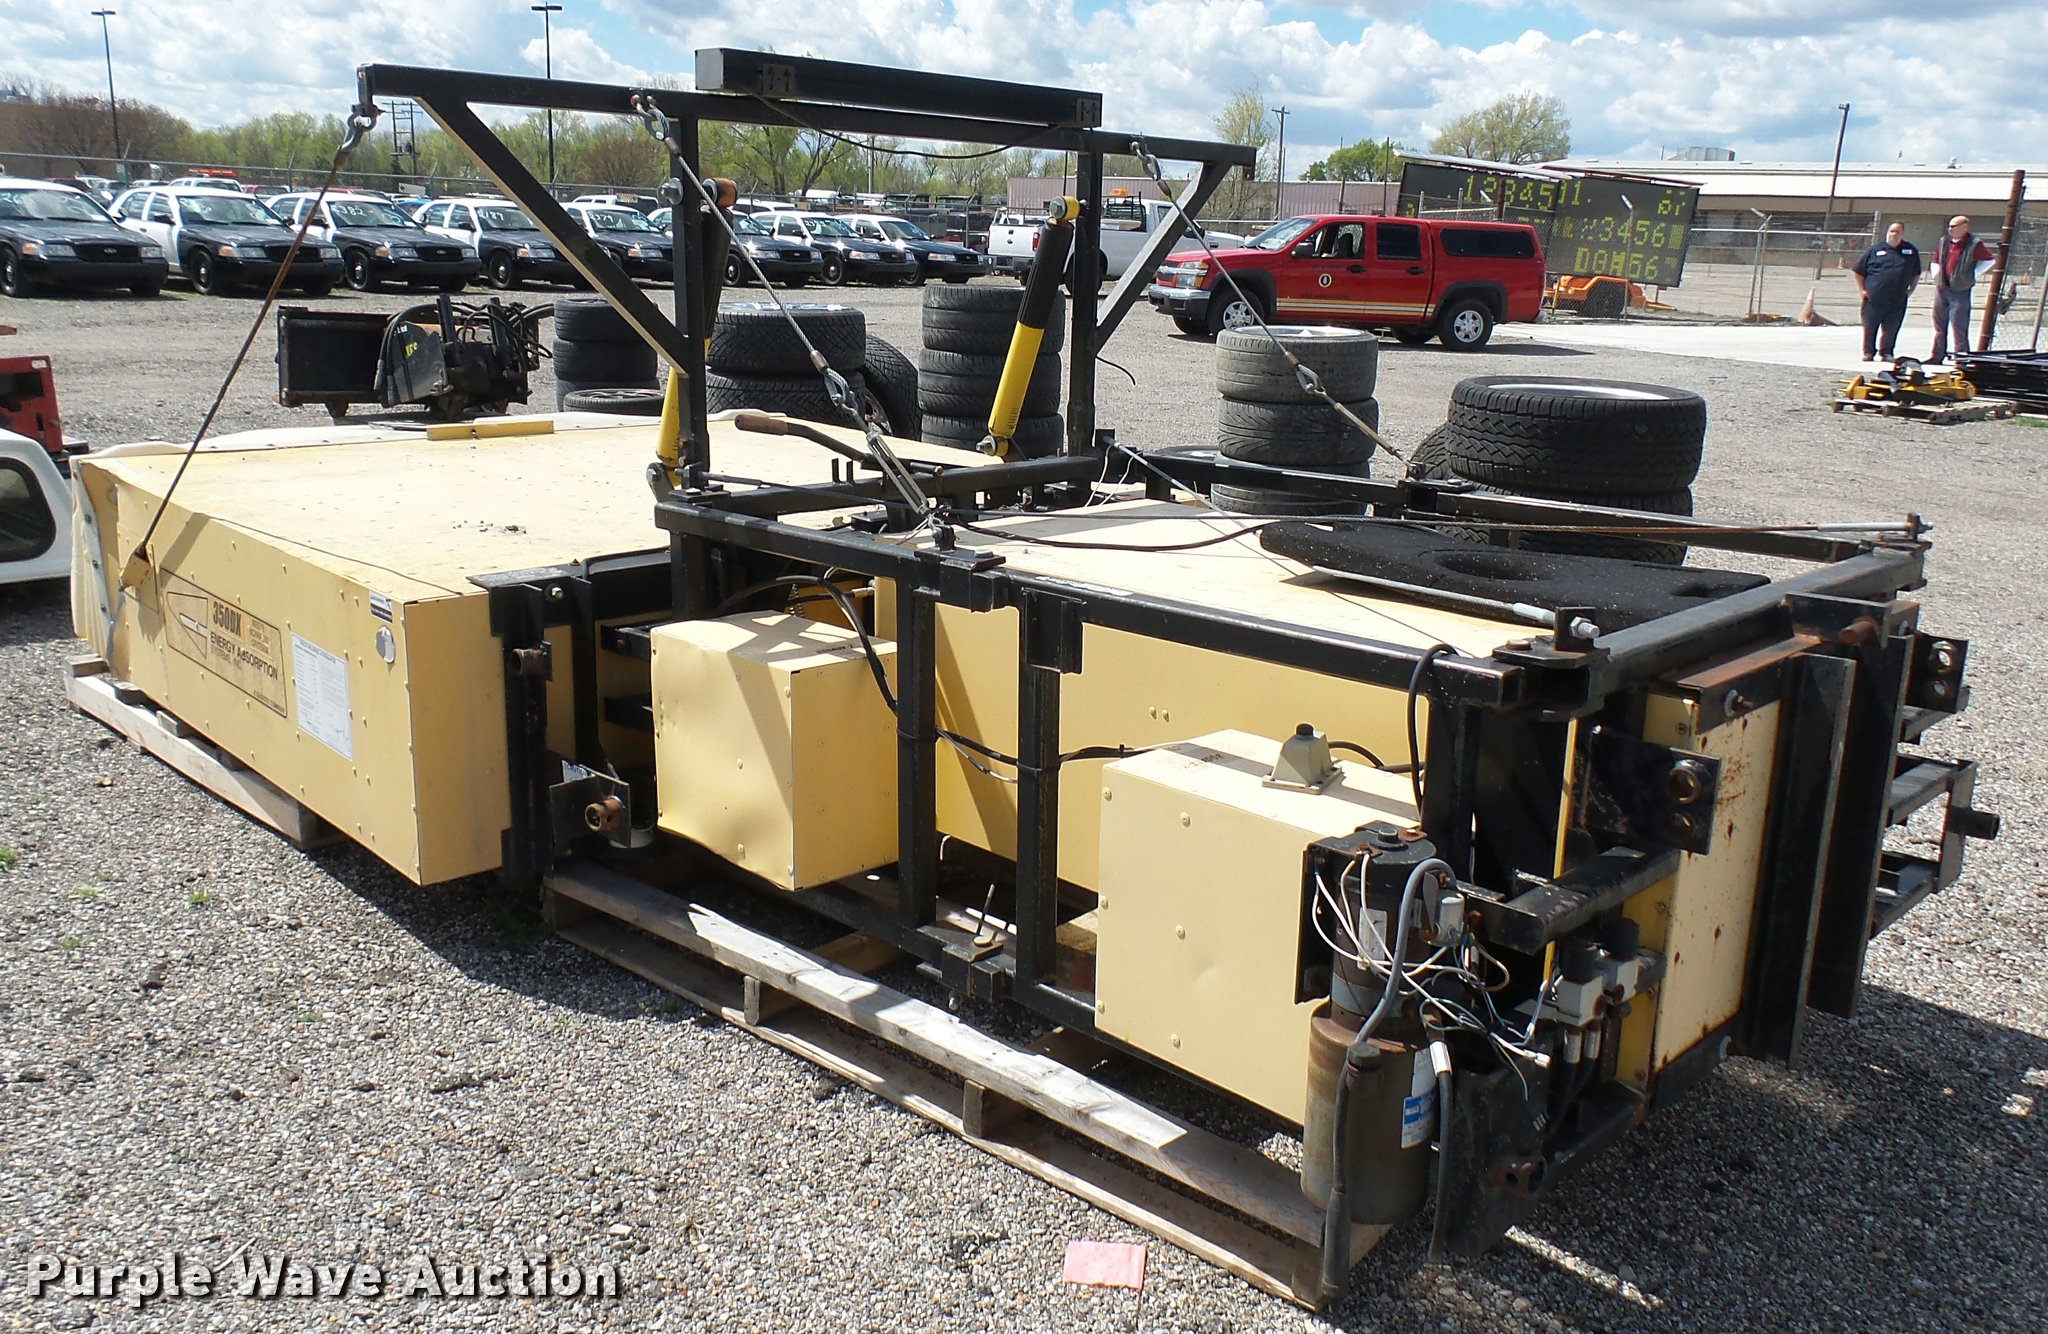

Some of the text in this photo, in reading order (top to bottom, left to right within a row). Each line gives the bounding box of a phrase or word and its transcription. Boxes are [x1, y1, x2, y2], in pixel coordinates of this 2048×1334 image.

[213, 601, 242, 637] 350DX
[210, 631, 236, 655] ENERGY
[236, 646, 279, 681] ABSORPTION
